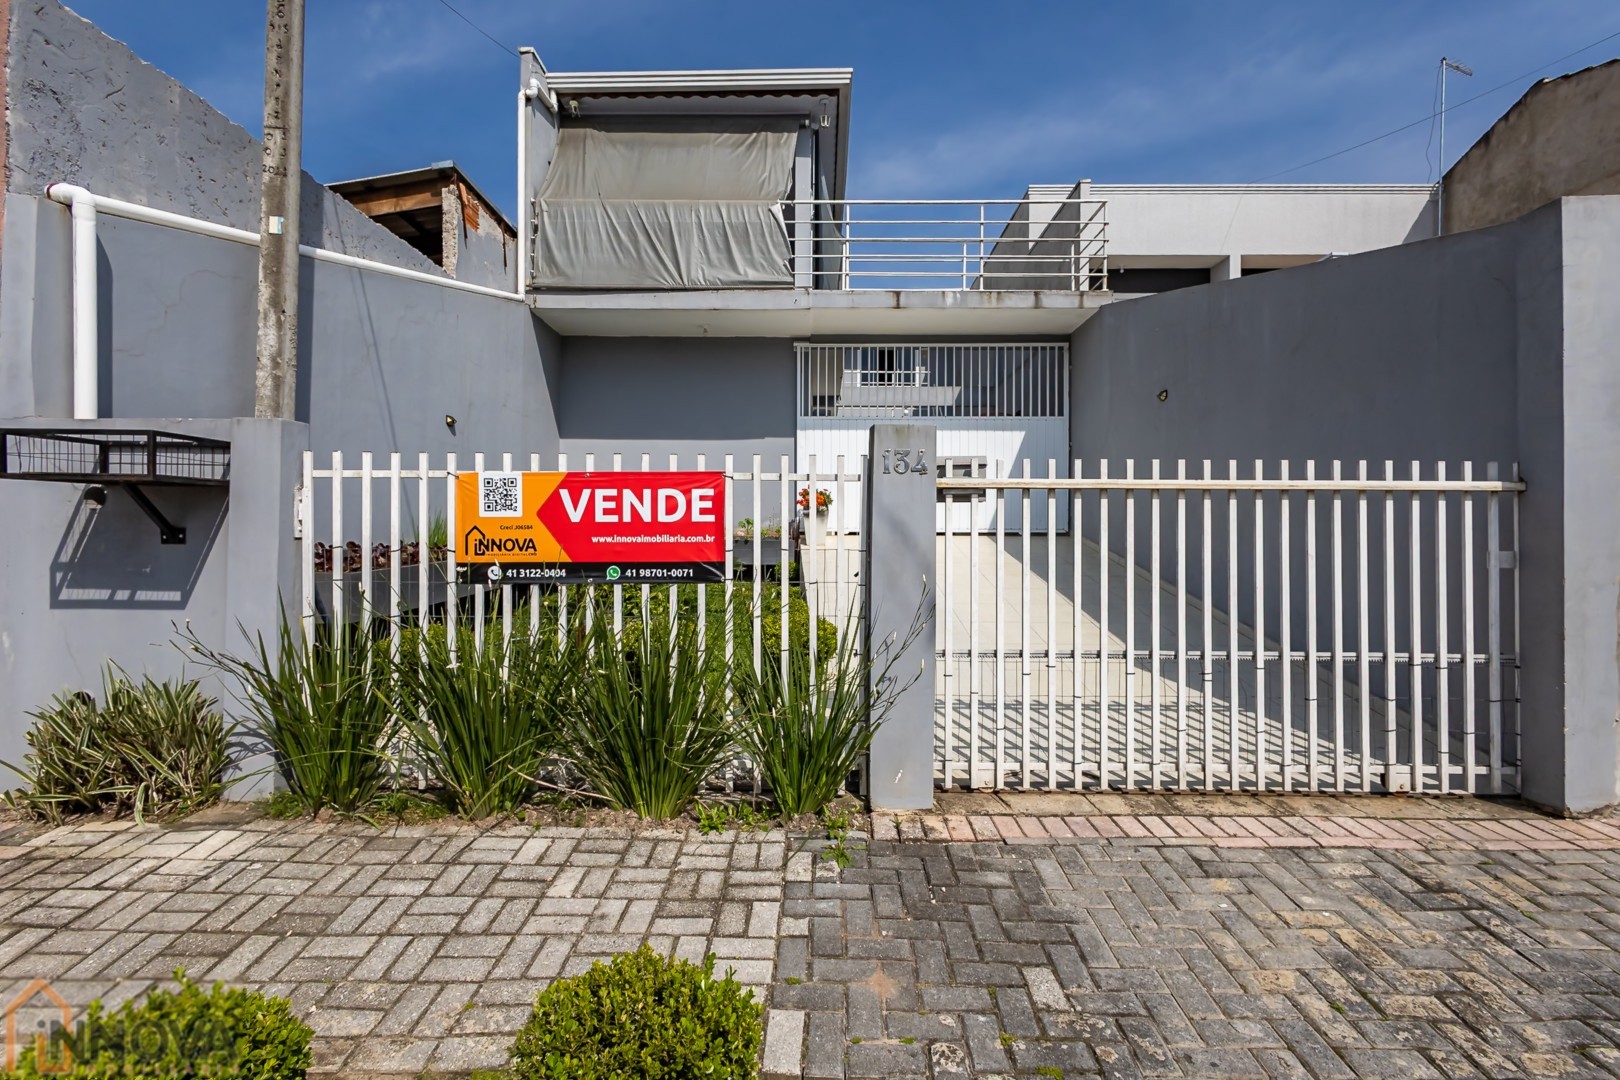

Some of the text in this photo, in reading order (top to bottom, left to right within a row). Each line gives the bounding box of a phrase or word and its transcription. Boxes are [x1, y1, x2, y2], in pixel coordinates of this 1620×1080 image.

[882, 448, 928, 475] 134
[559, 488, 715, 523] VENDE
[591, 534, 715, 543] www.innovaimobiliaria.com.br
[506, 568, 567, 578] 41 3122-0404
[625, 568, 694, 577] 41 98701-0071
